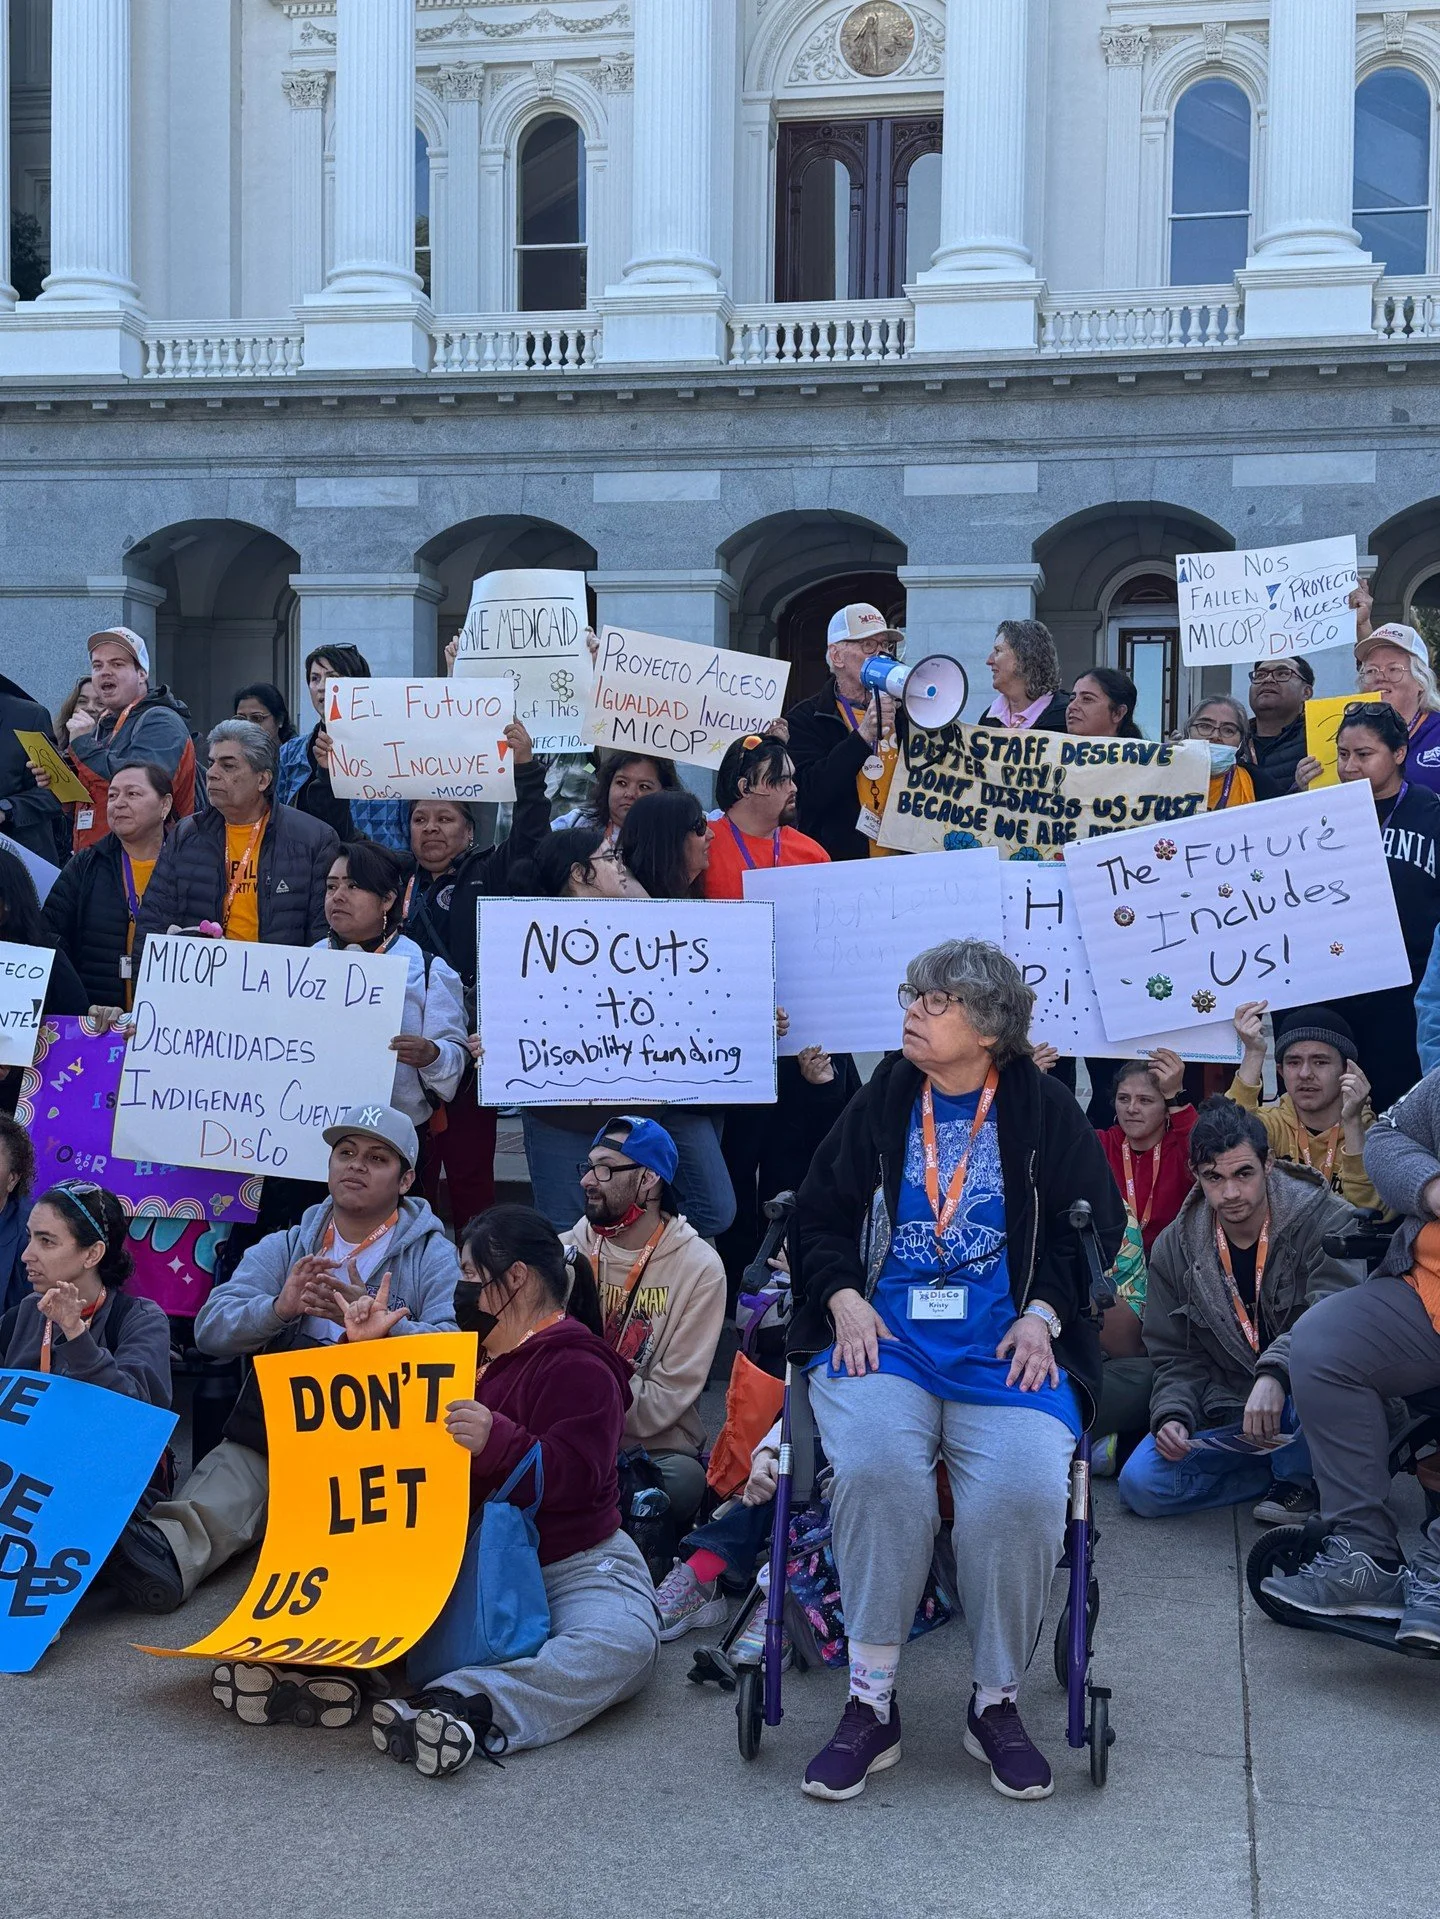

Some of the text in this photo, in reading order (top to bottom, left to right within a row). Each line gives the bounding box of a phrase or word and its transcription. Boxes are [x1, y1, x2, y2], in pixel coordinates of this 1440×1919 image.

[497, 606, 578, 649] MEDICAID
[1189, 613, 1262, 652] MICOP
[603, 632, 777, 700] PROYECTO ACCESO
[595, 676, 689, 720] IGUALDAD
[612, 717, 708, 754] MICOP
[969, 731, 1050, 765] STAFF
[1061, 741, 1174, 767] DESERVE
[330, 744, 372, 778] NOS
[897, 791, 989, 832] BECAUSE
[994, 814, 1029, 844] WE
[1036, 820, 1077, 845] ARE
[980, 782, 1083, 820] DISMISS
[1093, 795, 1126, 823] US
[1131, 792, 1205, 822] JUST
[1097, 824, 1346, 895] The Future
[1146, 869, 1351, 952] Includes
[146, 941, 228, 987] MICOP
[521, 921, 599, 978] NO
[596, 987, 655, 1028] to
[51, 1057, 84, 1092] MY
[519, 1034, 741, 1075] Disability funding
[289, 1362, 456, 1433] DON'T
[329, 1464, 426, 1536] LET
[252, 1566, 329, 1620] US
